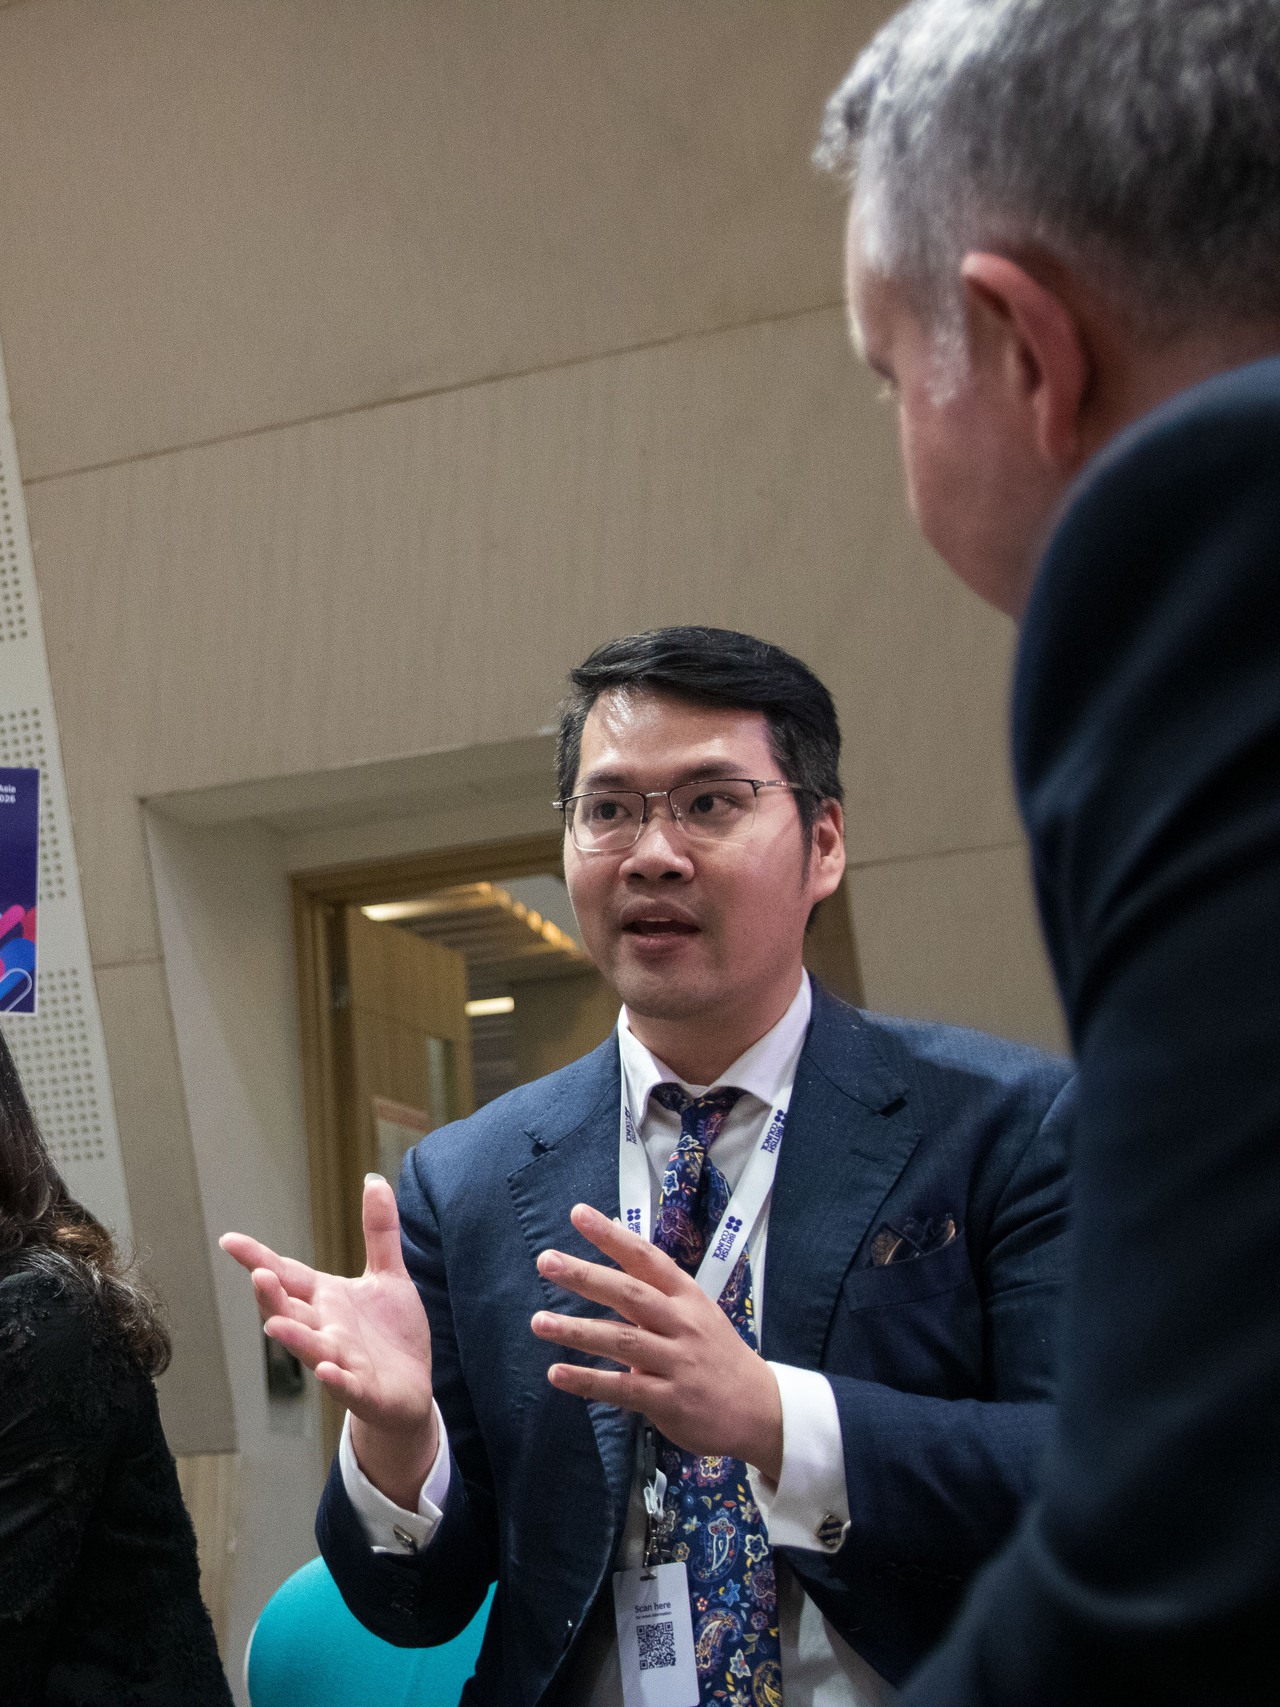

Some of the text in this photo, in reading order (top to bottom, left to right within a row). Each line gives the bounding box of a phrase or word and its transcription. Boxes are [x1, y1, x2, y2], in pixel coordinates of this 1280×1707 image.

[760, 1122, 778, 1151] COUNCIL
[767, 1125, 784, 1154] BRITISH
[712, 1229, 730, 1259] COUNCIL
[719, 1232, 737, 1262] BRITISH
[635, 1602, 671, 1613] Scan here
